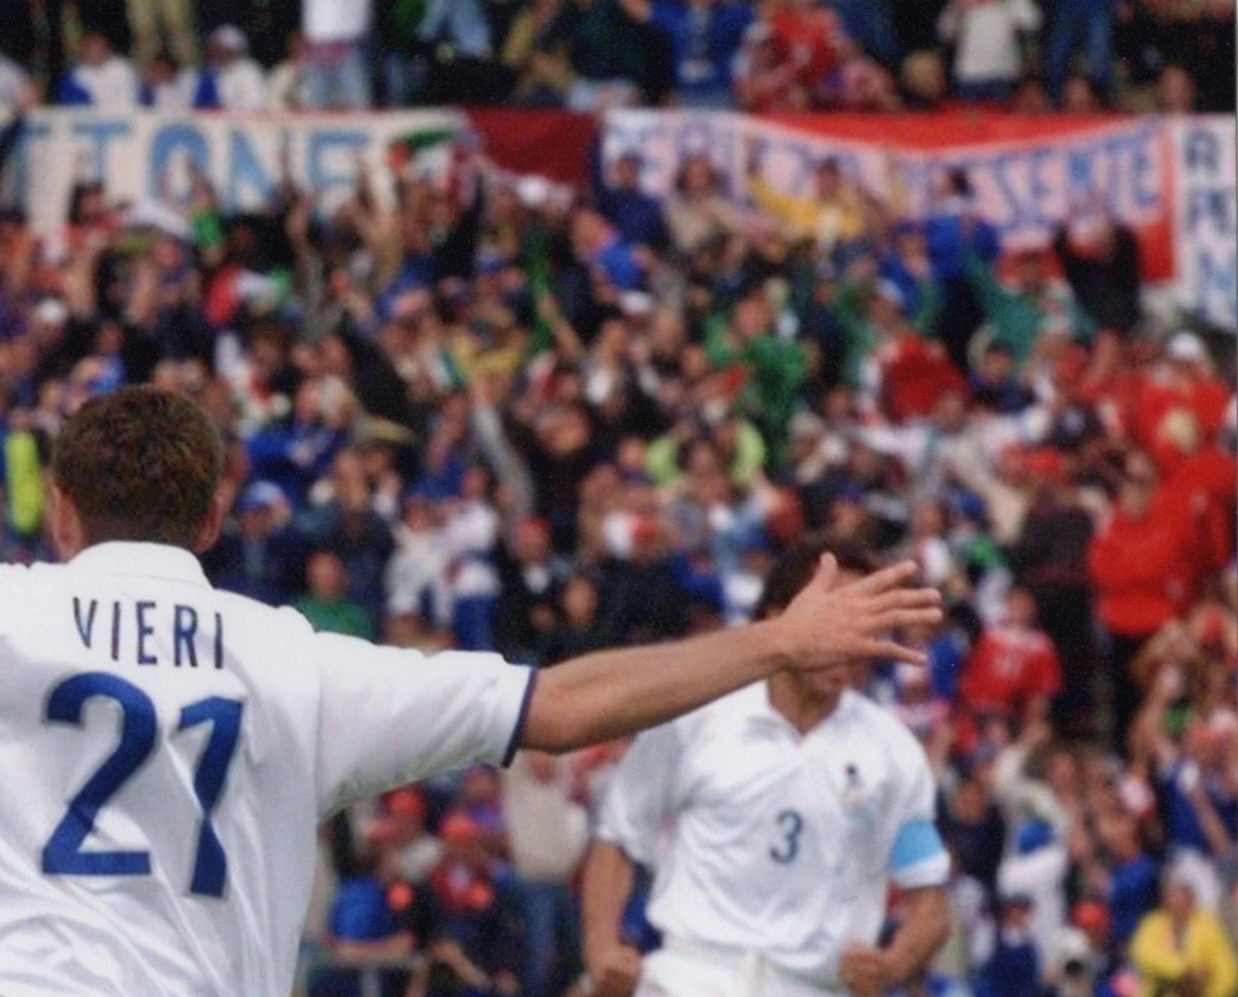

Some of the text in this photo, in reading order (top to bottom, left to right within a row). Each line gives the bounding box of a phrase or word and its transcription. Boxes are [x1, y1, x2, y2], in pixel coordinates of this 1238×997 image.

[73, 596, 224, 669] VIERI
[41, 671, 244, 898] 21
[769, 810, 804, 864] 3
